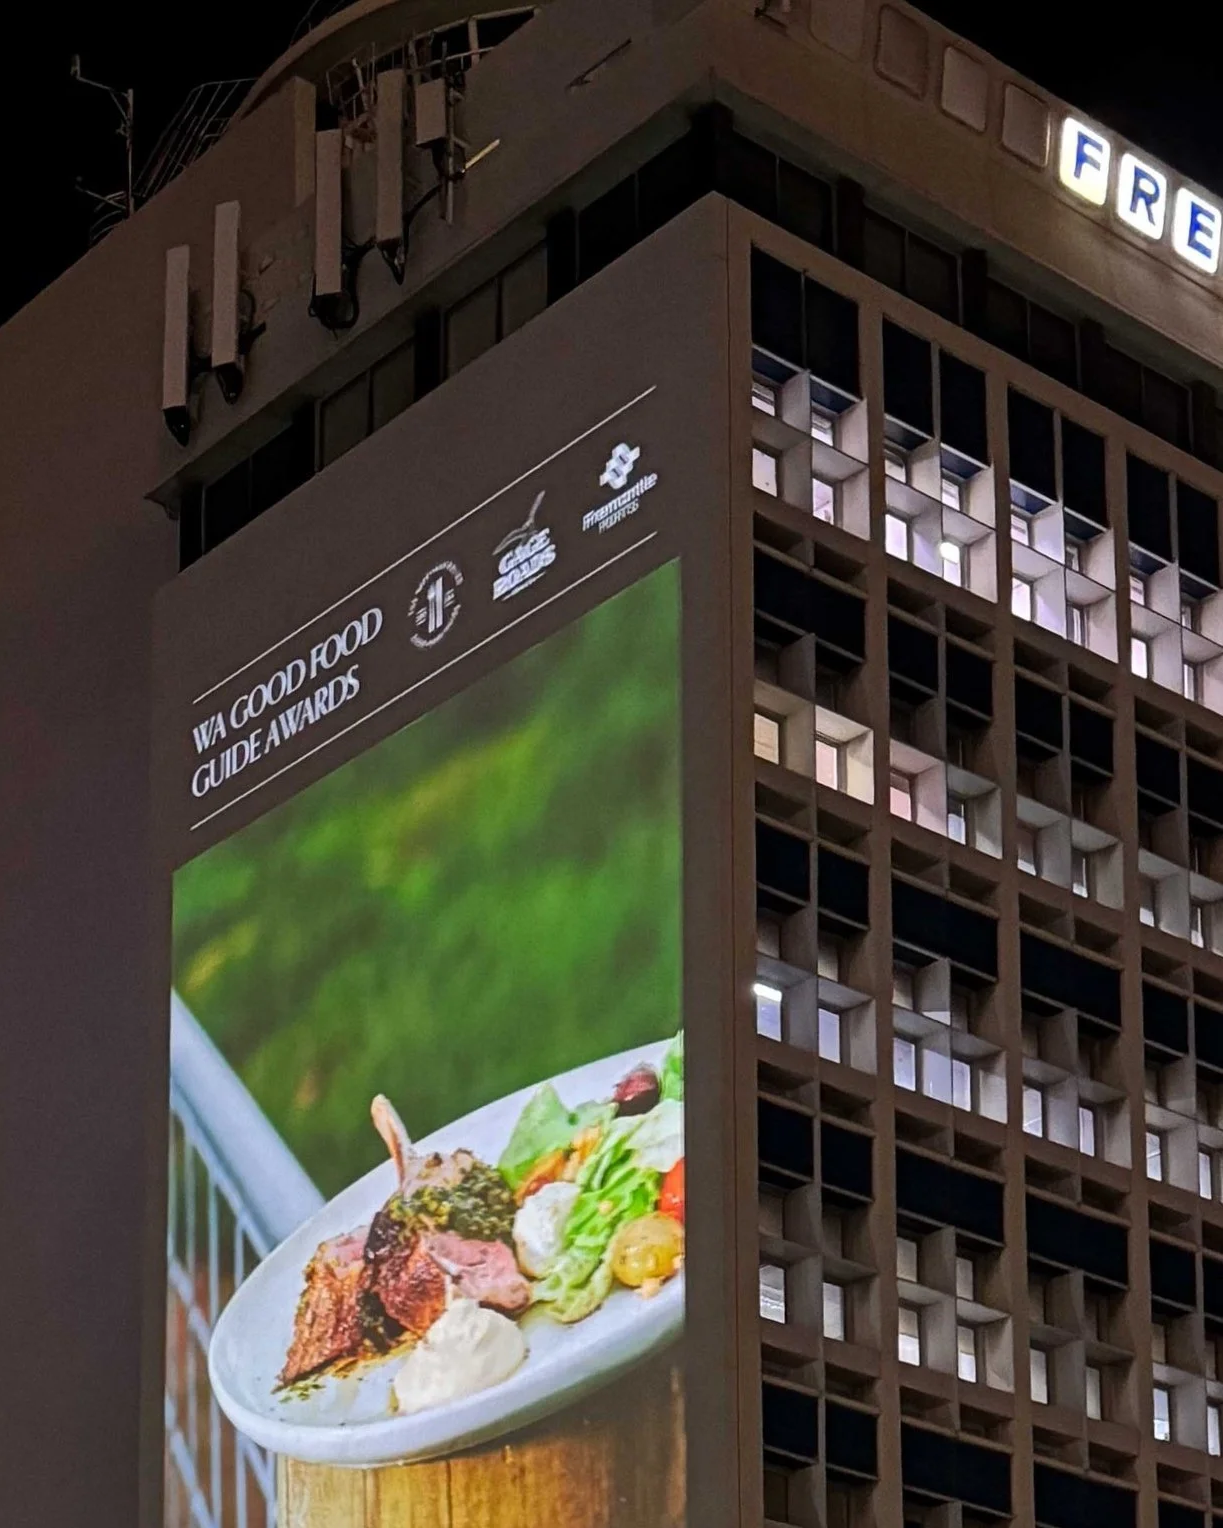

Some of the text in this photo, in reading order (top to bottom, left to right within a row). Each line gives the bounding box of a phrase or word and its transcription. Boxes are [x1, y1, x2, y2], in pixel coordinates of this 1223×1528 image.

[191, 664, 361, 798] GUIDE AWARDS
[192, 607, 384, 755] WA GOOD FOOD
